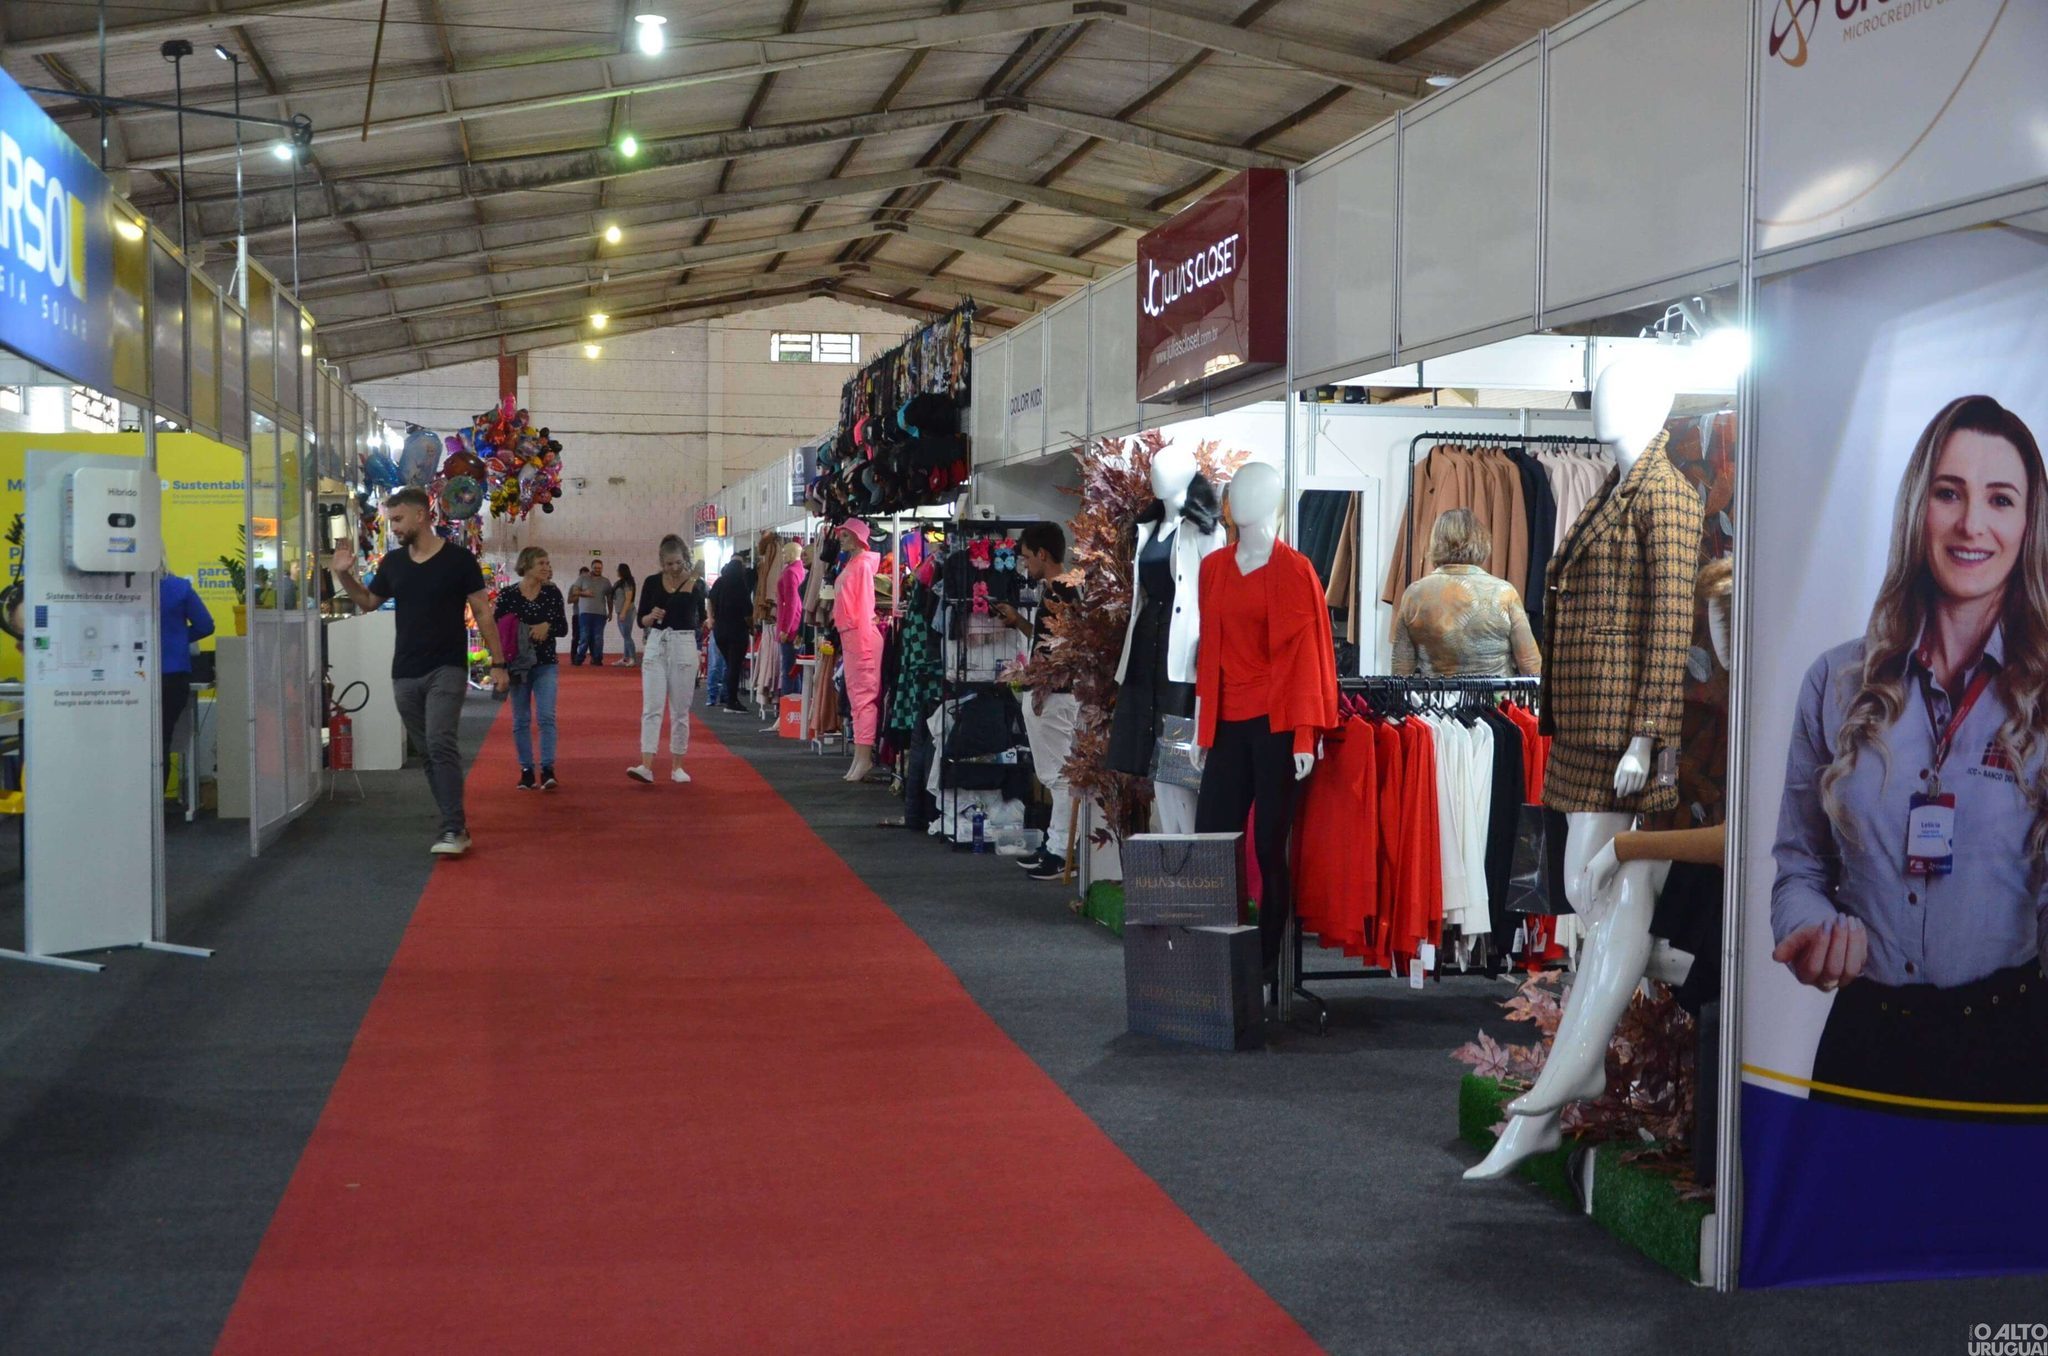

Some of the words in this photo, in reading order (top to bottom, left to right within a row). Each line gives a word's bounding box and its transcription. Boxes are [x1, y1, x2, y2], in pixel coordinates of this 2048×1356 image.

[0, 130, 87, 303] RSOL
[1195, 233, 1239, 289] CLOSET
[42, 294, 87, 341] SOLAR
[1010, 392, 1030, 416] COLOR
